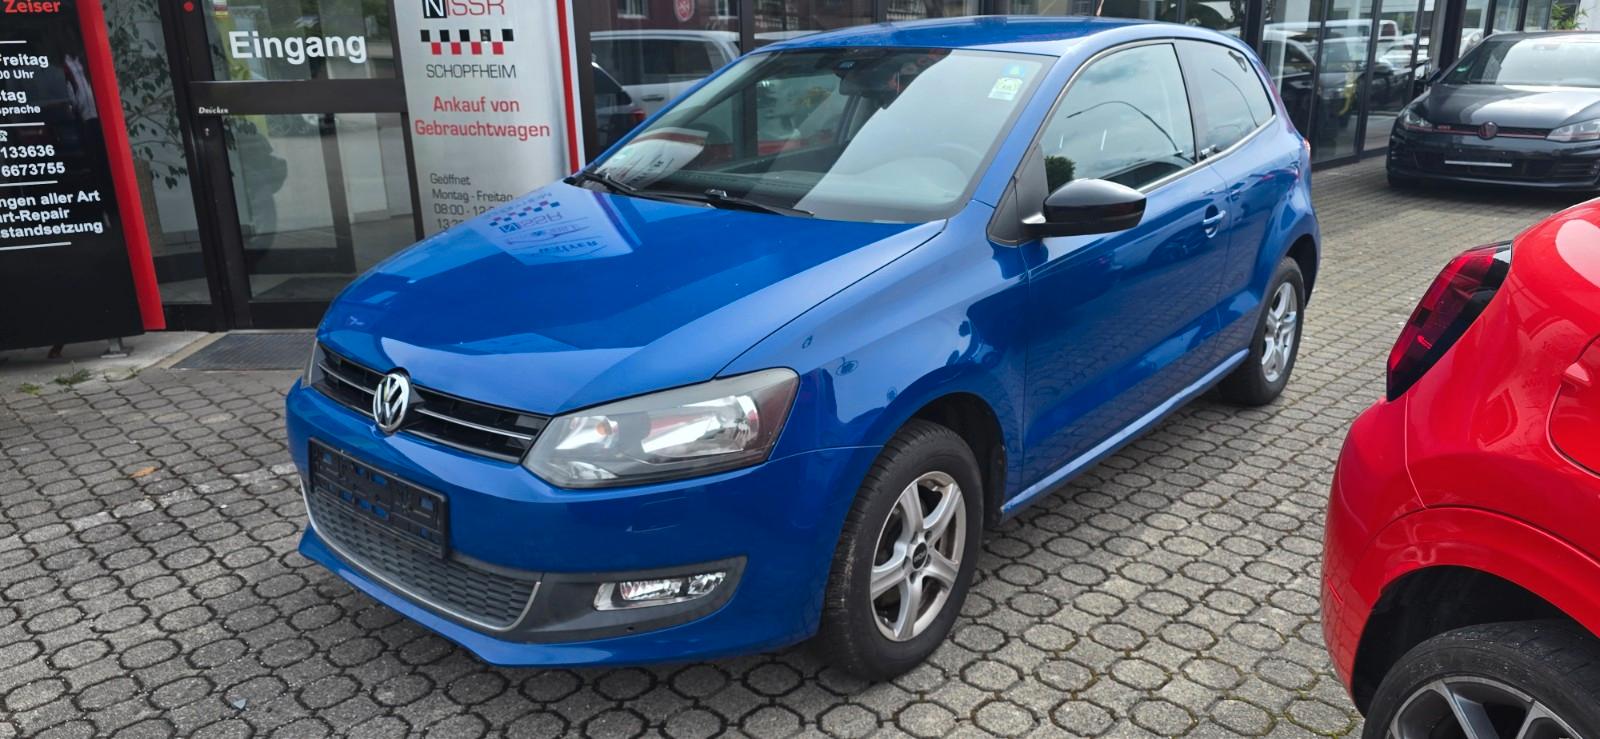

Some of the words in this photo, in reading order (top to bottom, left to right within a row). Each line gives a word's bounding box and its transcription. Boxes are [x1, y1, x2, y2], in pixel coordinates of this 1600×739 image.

[3, 0, 60, 13] Zeiser
[229, 31, 367, 65] Eingang
[0, 54, 49, 68] reitag
[13, 70, 34, 79] Uhr
[426, 64, 517, 79] SCHOPFHEIM
[0, 90, 27, 104] tag
[433, 96, 486, 112] Ankauf
[491, 101, 520, 112] von
[415, 120, 550, 141] Gebrauchtwagen
[0, 145, 55, 158] 133636
[1, 162, 65, 177] 6673755
[430, 173, 471, 185] Geöffnet
[40, 192, 73, 205] aller
[77, 190, 101, 202] Art
[432, 188, 469, 203] Montag
[373, 373, 409, 431] VW
